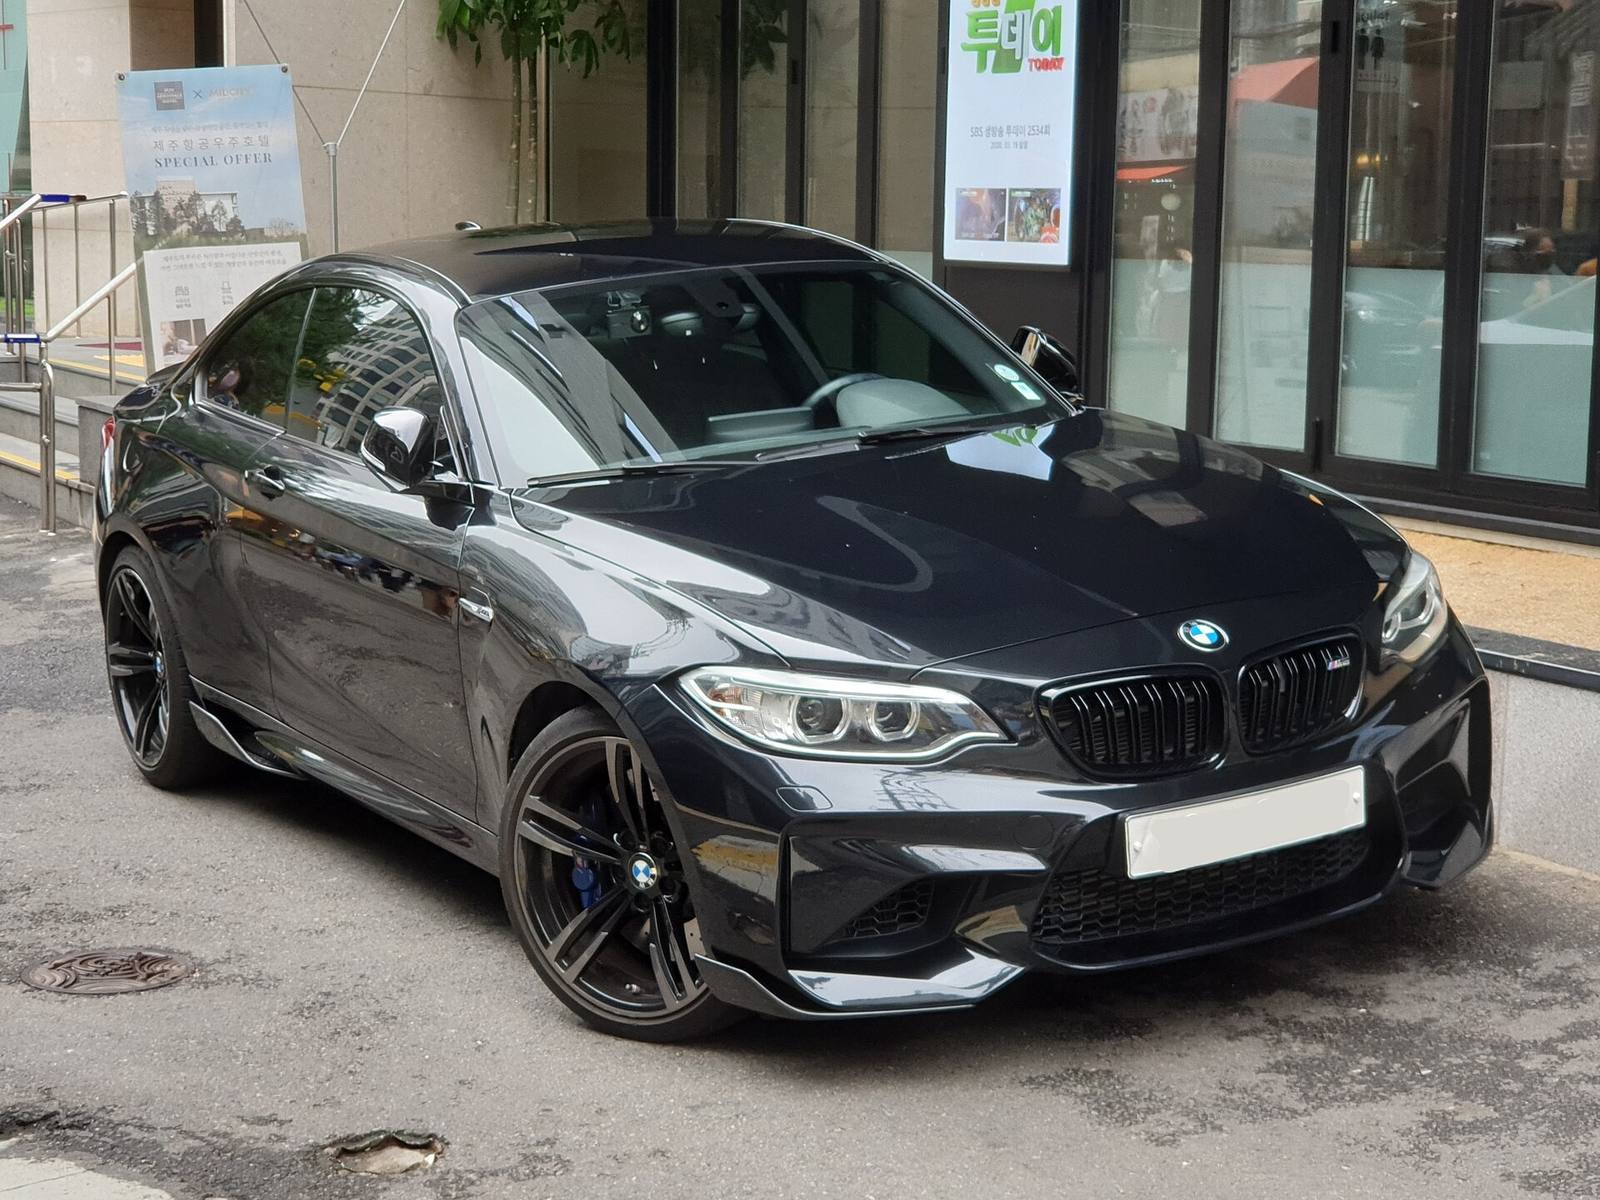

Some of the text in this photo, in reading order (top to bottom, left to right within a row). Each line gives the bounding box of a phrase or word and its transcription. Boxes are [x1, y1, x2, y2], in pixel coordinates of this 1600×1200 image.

[961, 5, 1062, 73] 투데이
[154, 152, 272, 169] SPECIAL OFFER
